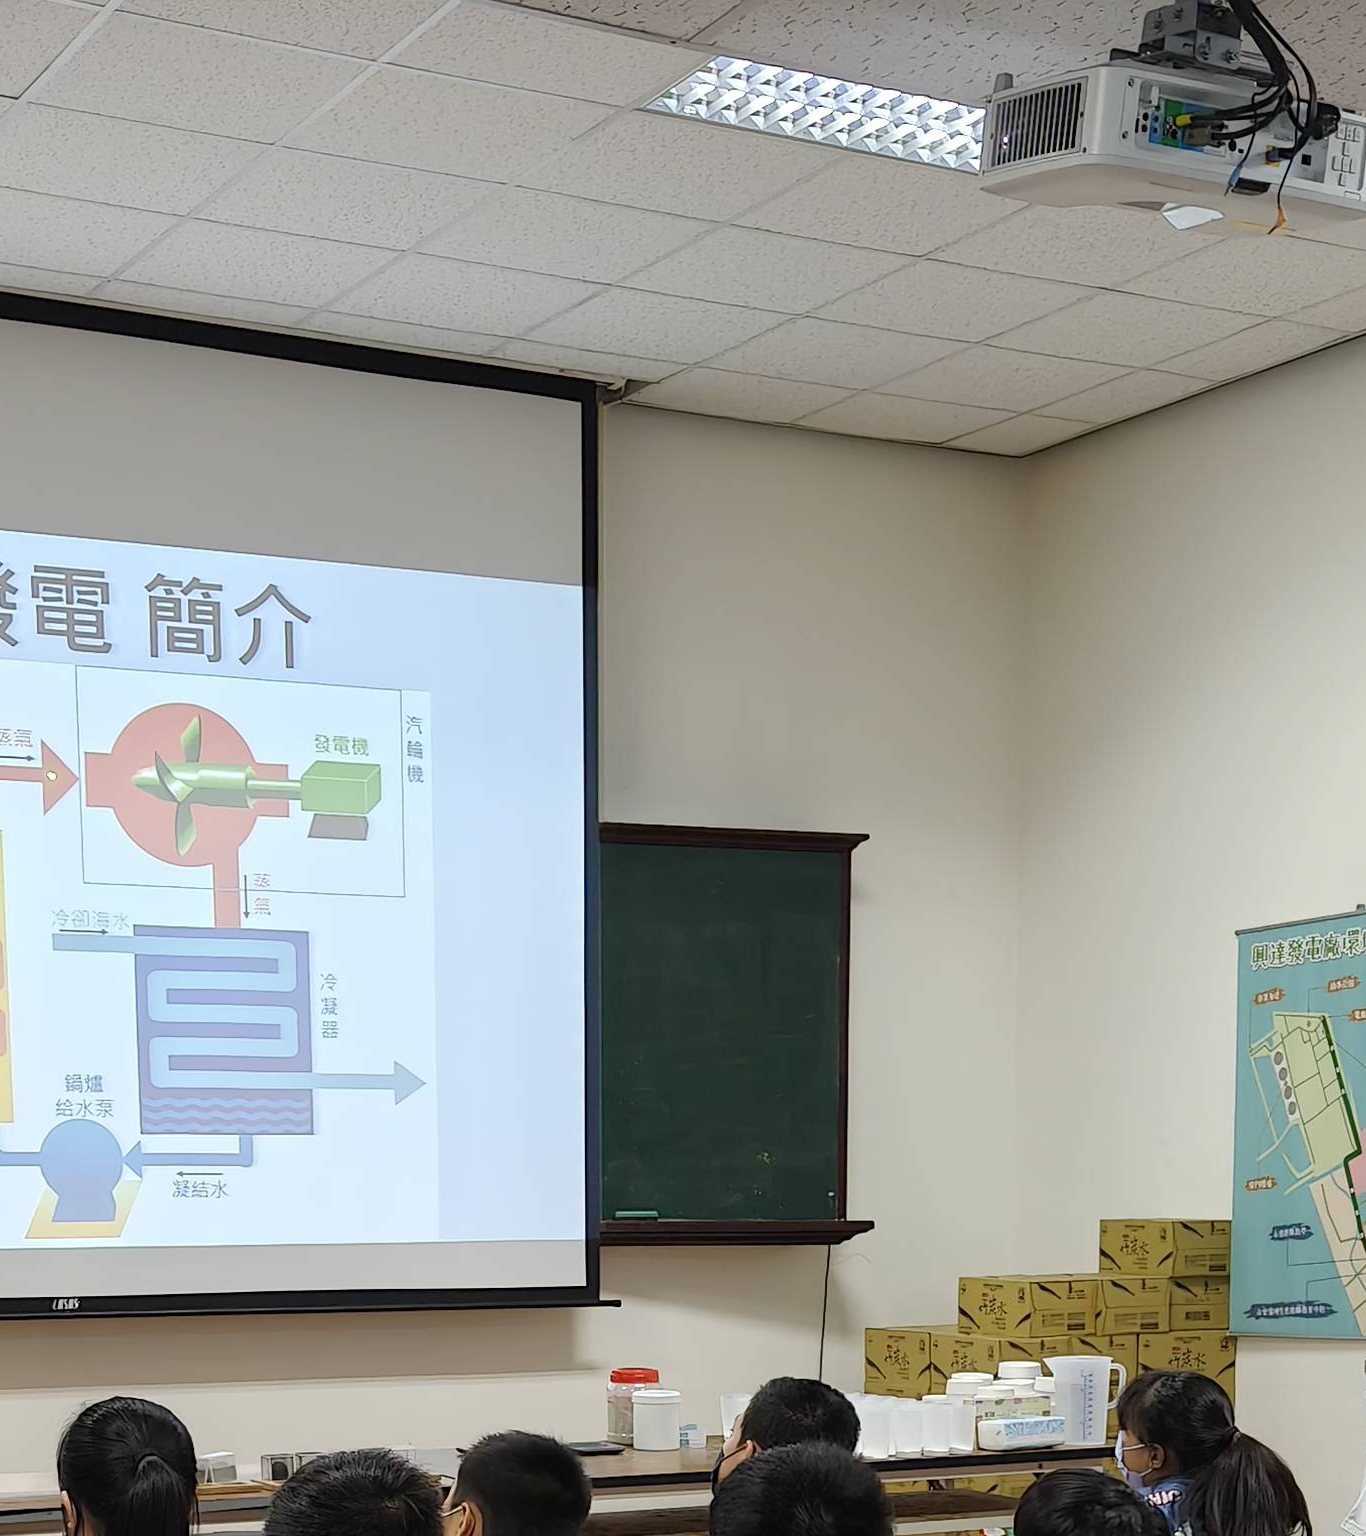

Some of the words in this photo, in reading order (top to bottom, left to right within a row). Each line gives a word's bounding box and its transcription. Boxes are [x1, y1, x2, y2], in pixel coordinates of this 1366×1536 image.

[144, 572, 311, 669] 簡介
[314, 734, 370, 758] 發電機
[405, 714, 425, 784] 汽輪機
[320, 972, 339, 1039] 冷凝器
[64, 1073, 104, 1094] 鍋爐
